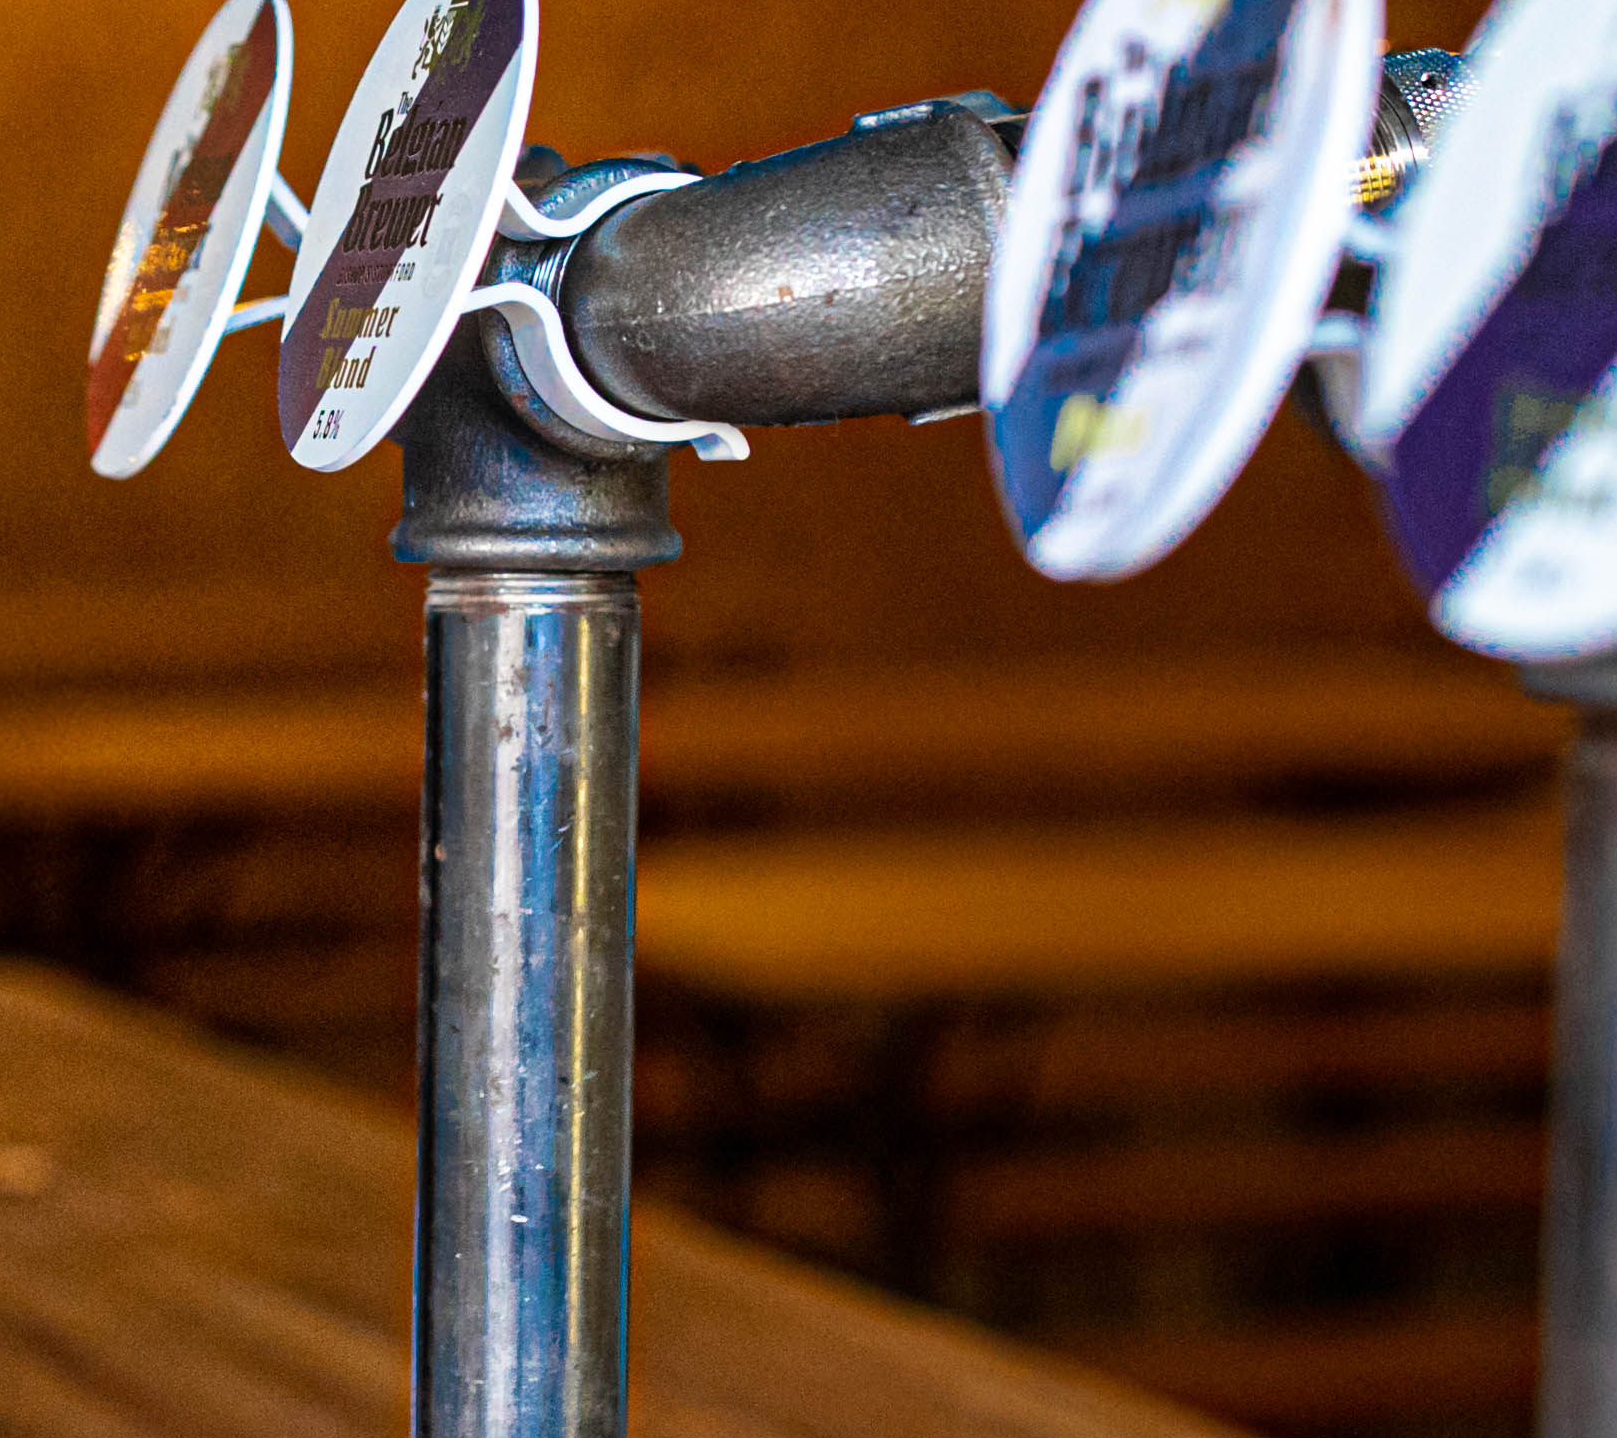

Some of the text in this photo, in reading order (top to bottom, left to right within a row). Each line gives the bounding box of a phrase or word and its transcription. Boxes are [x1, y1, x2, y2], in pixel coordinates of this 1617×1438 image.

[397, 91, 414, 115] The
[364, 100, 467, 179] Belgian
[342, 181, 444, 254] Brewer
[319, 297, 401, 339] Summer
[316, 345, 378, 389] Blond
[312, 409, 345, 439] 5.8%
